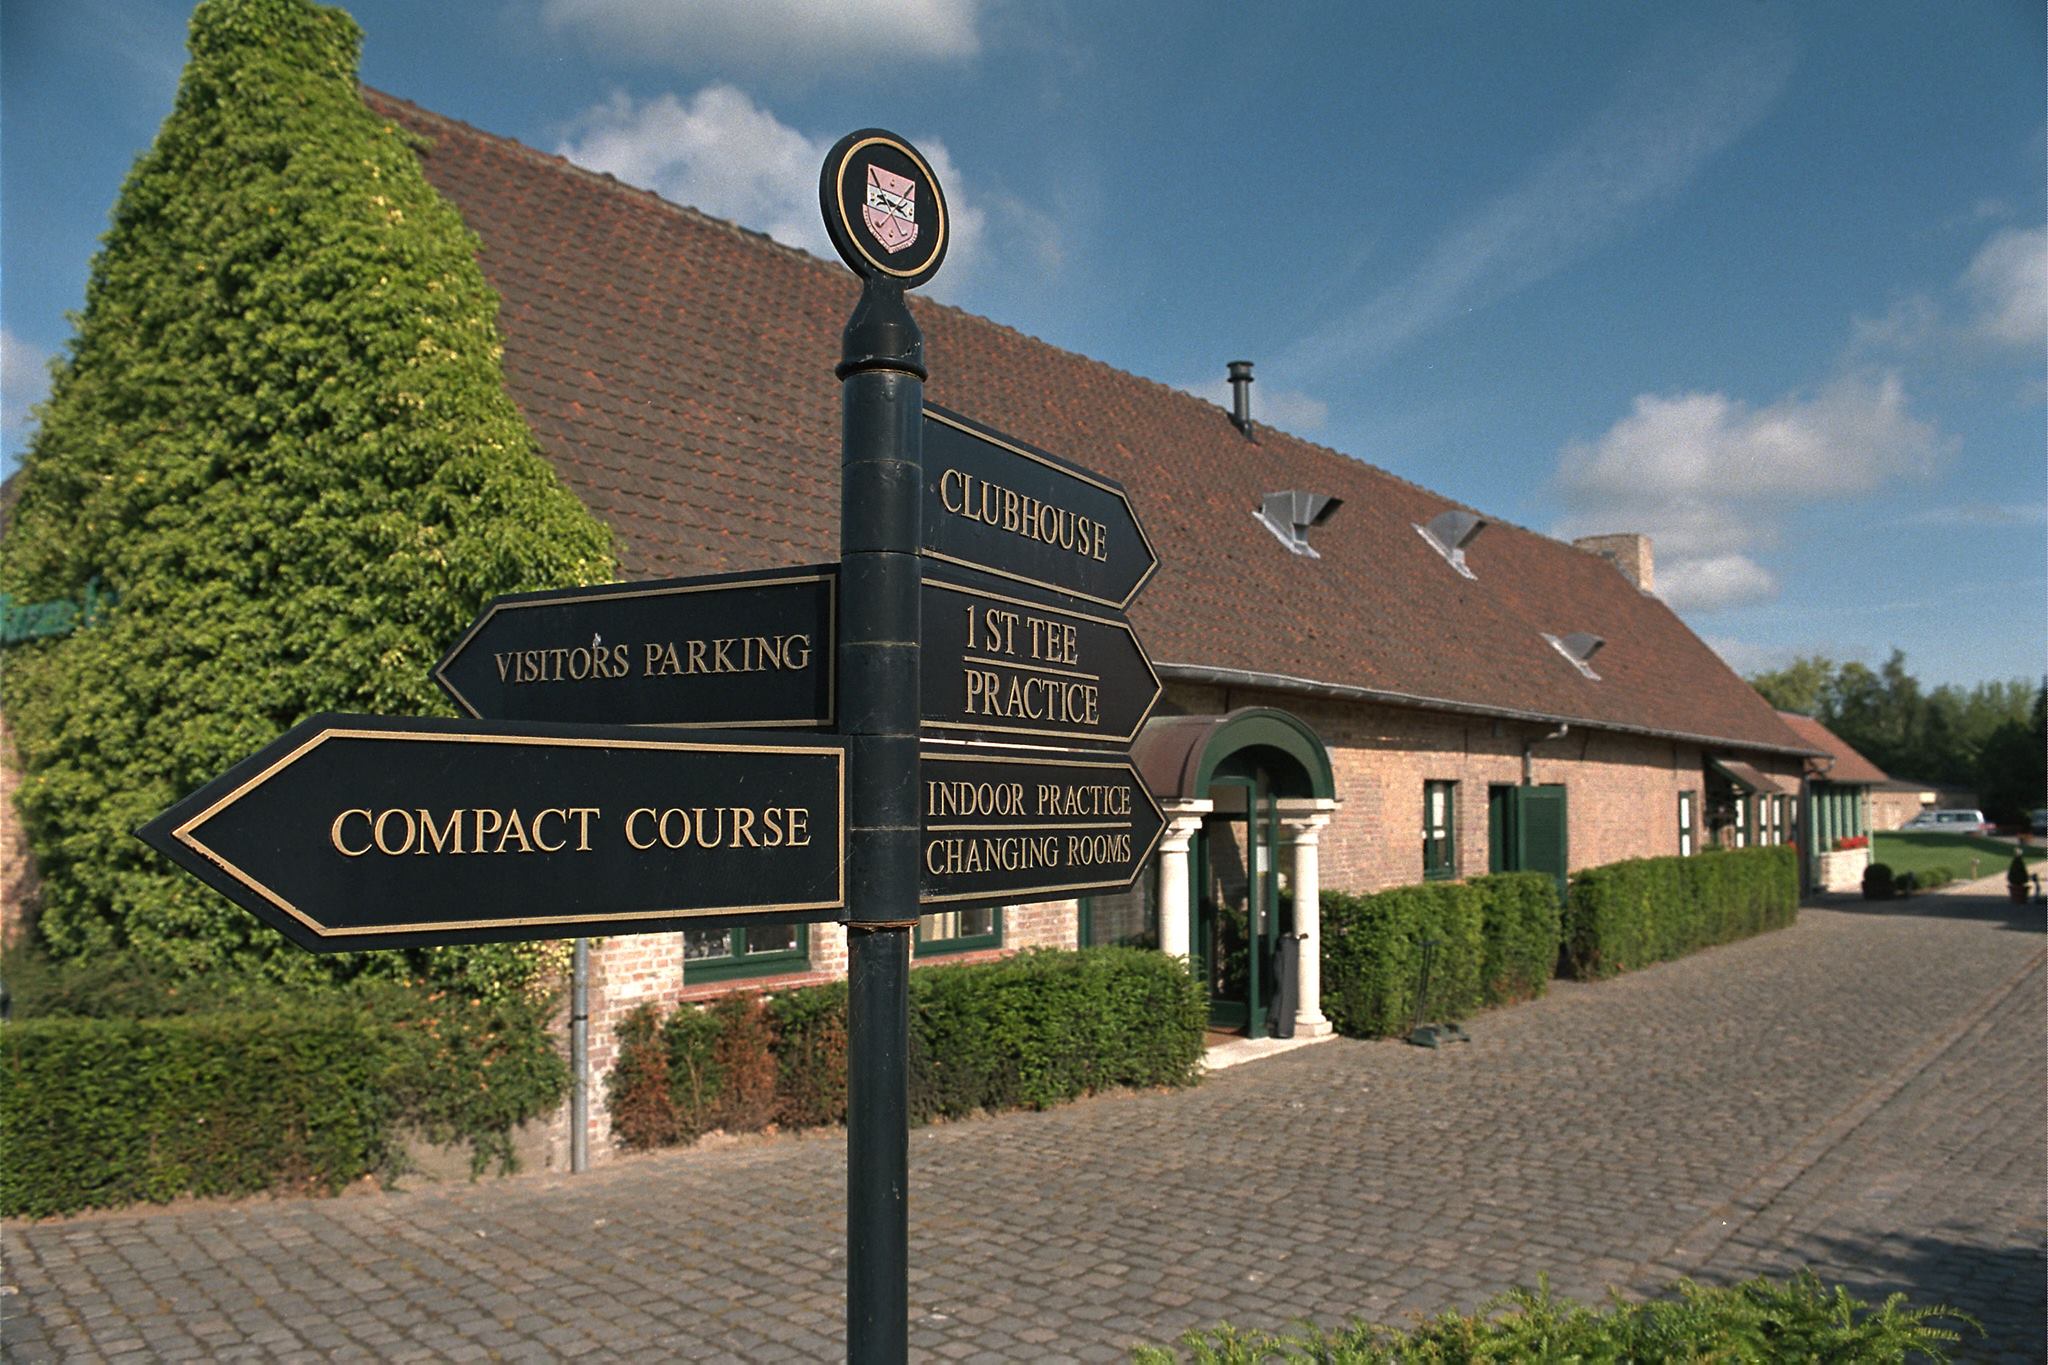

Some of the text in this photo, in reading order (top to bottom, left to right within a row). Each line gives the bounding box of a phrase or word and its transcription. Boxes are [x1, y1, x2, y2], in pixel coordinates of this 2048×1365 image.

[940, 468, 1108, 562] CLUBHOUSE
[494, 633, 812, 684] VISITORS PARKING
[964, 669, 1100, 725] PRACTICE
[927, 780, 1132, 817] INDOOR PRACTICE
[332, 807, 811, 857] COMPACT COURSE
[926, 833, 1131, 875] CHANGING ROOMS
